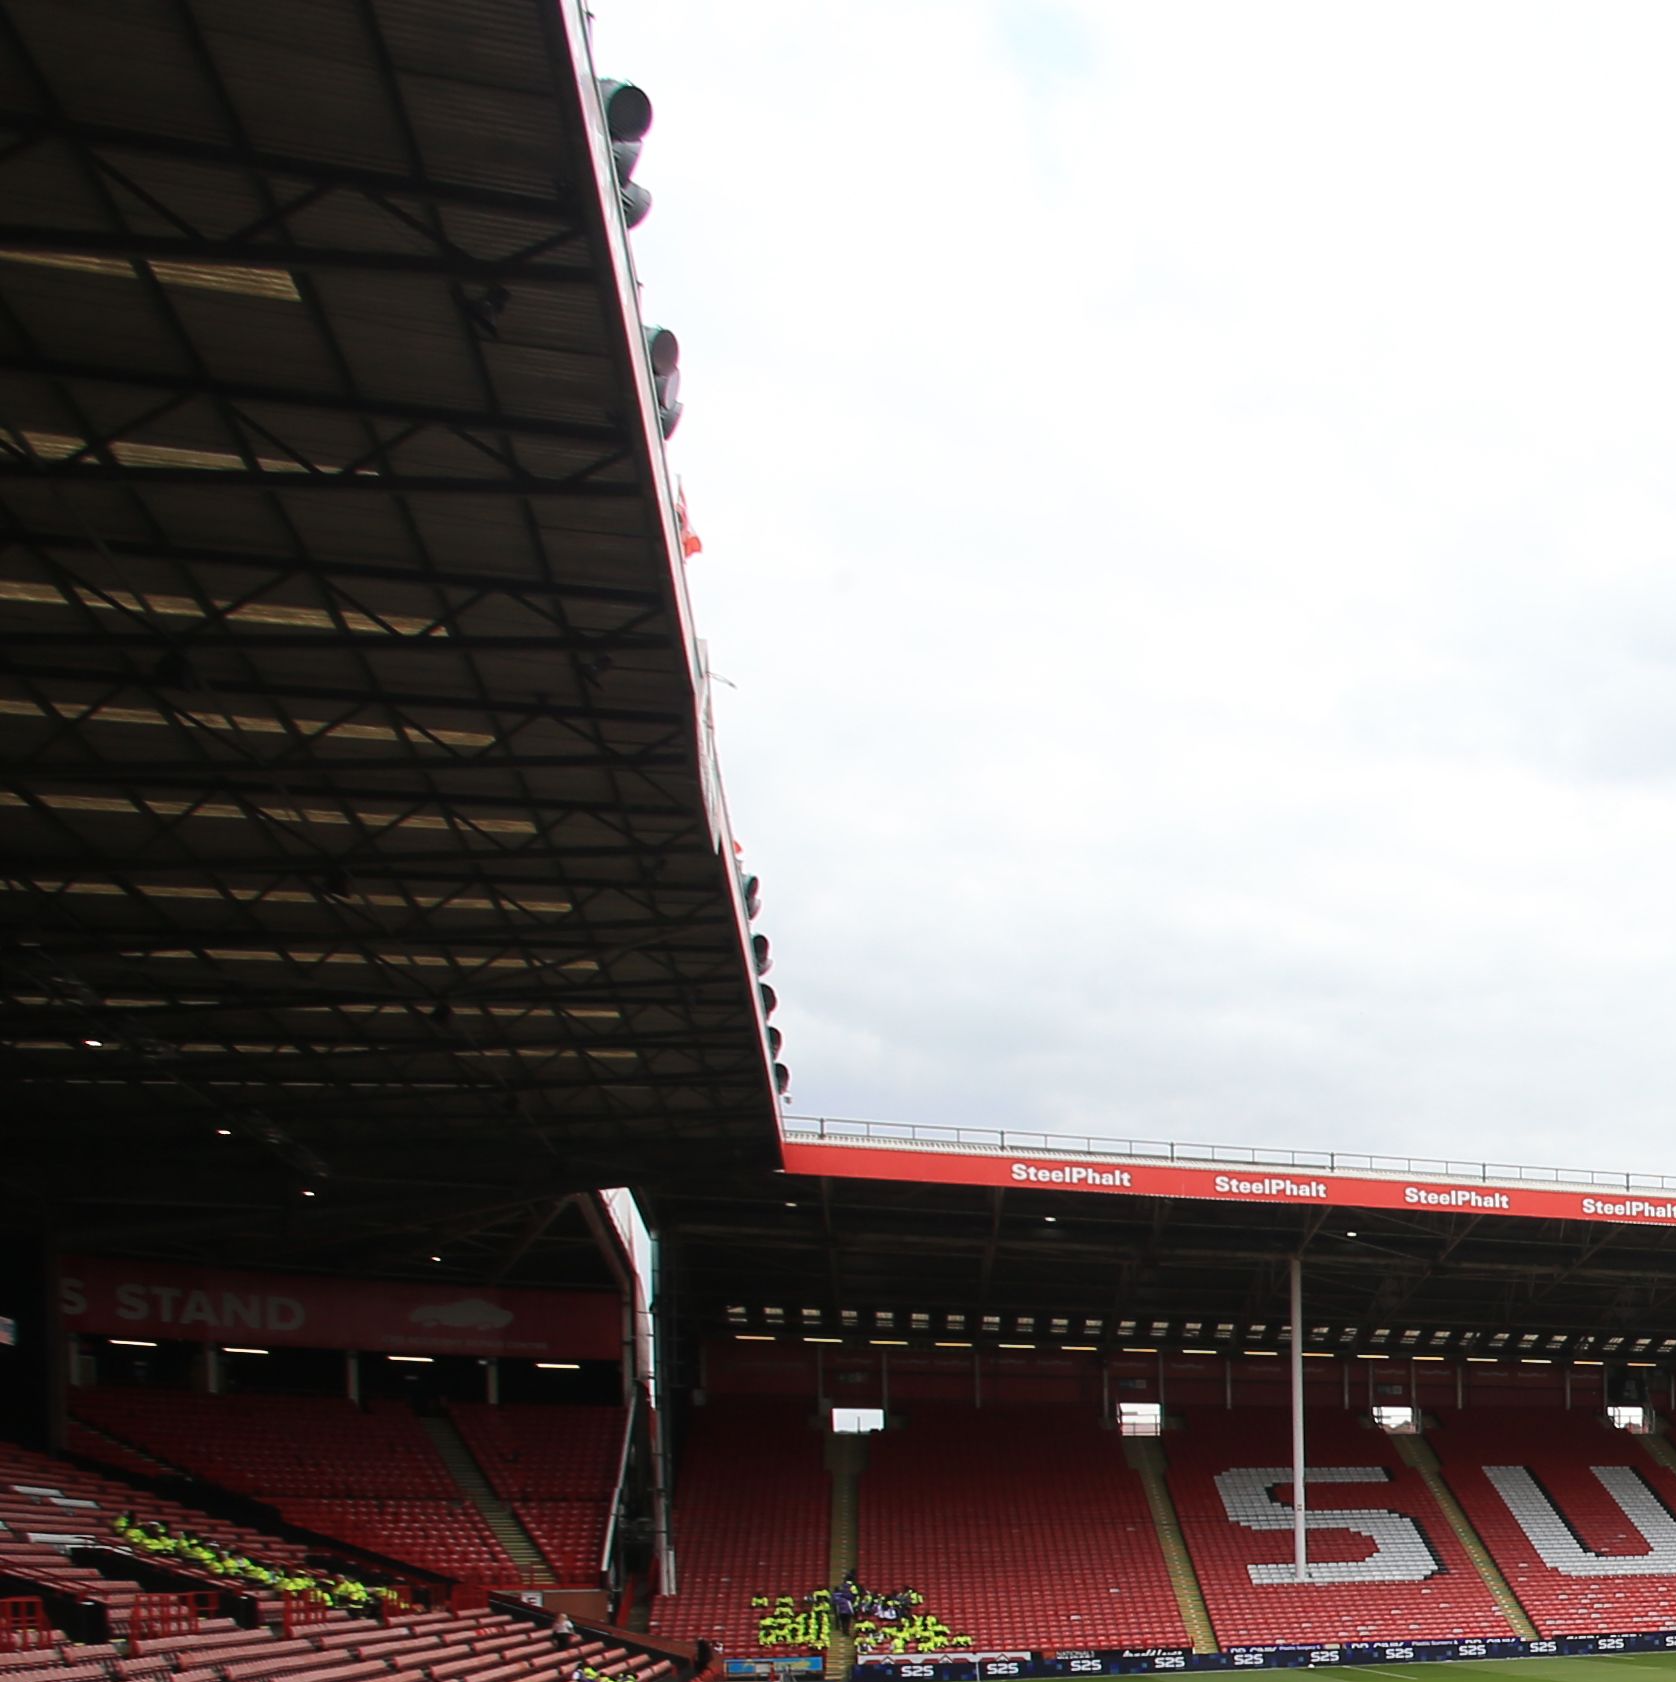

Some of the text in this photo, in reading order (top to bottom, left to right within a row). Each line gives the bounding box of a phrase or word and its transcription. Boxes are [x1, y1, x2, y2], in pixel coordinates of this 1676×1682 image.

[1011, 1163, 1132, 1187] SteelPhalt
[1215, 1176, 1328, 1198] SteelPhalt
[1404, 1186, 1510, 1210] SteelPhalt
[115, 1284, 306, 1332] STAND
[1530, 1641, 1557, 1653] S2S
[1598, 1638, 1625, 1649] S2S
[1386, 1648, 1414, 1659] S2S
[1459, 1645, 1487, 1656] S2S
[1233, 1654, 1264, 1665] S2S
[1310, 1651, 1340, 1662] S2S
[1070, 1660, 1102, 1671] S2S
[1154, 1657, 1185, 1668] S2S
[901, 1665, 934, 1677] S2S
[986, 1663, 1019, 1675] S2S
